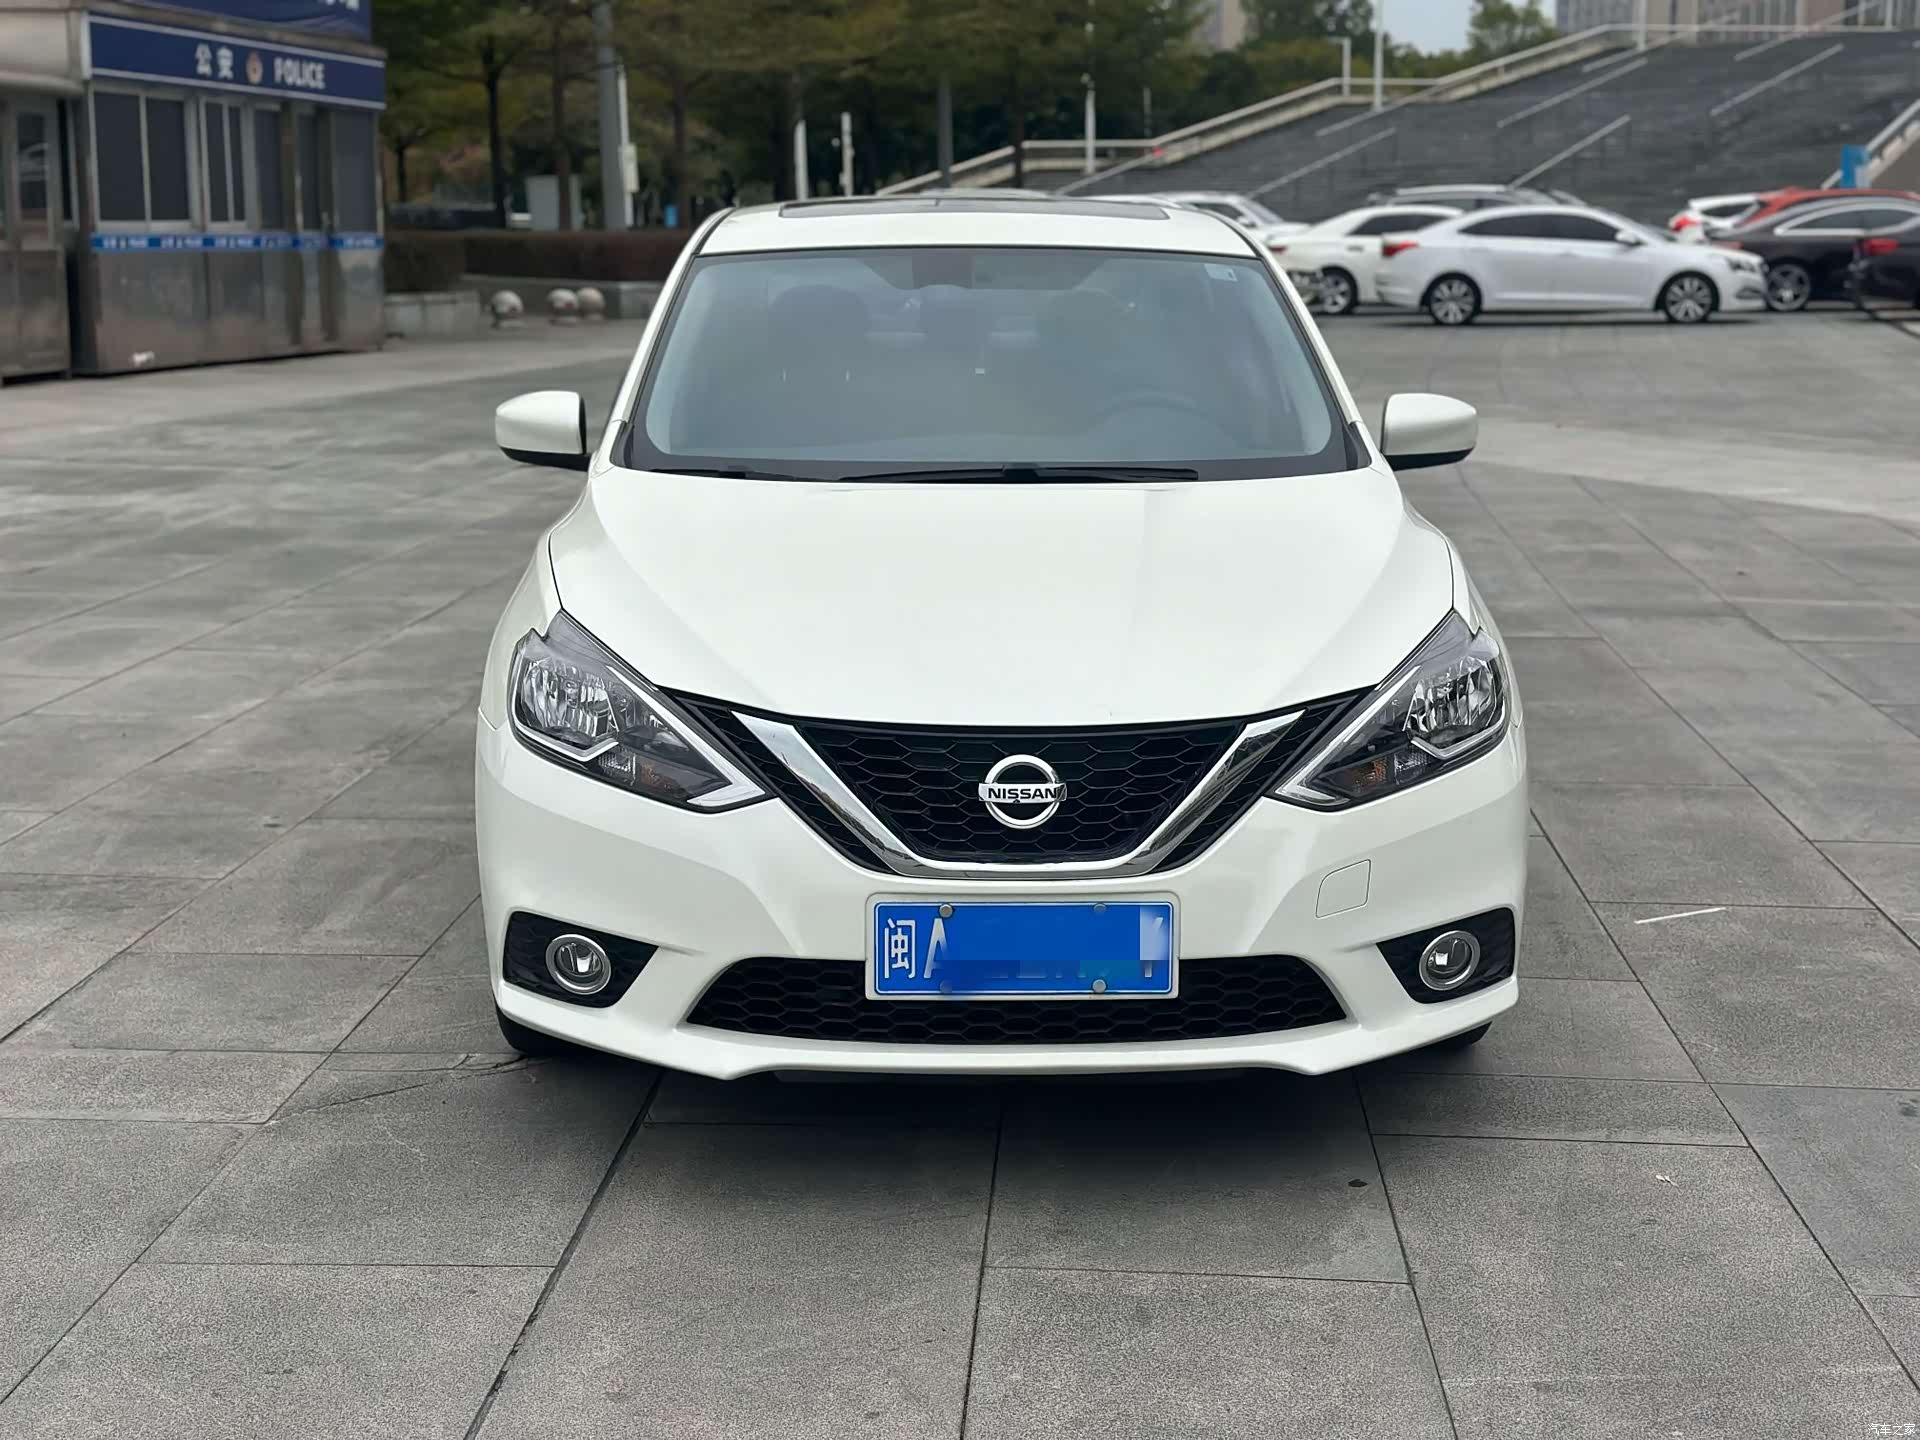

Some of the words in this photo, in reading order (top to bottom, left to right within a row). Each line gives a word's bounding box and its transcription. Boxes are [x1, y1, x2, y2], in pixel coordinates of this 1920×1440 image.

[195, 43, 234, 80] 公安
[273, 57, 326, 89] POLICE
[988, 787, 1057, 800] NISSAN
